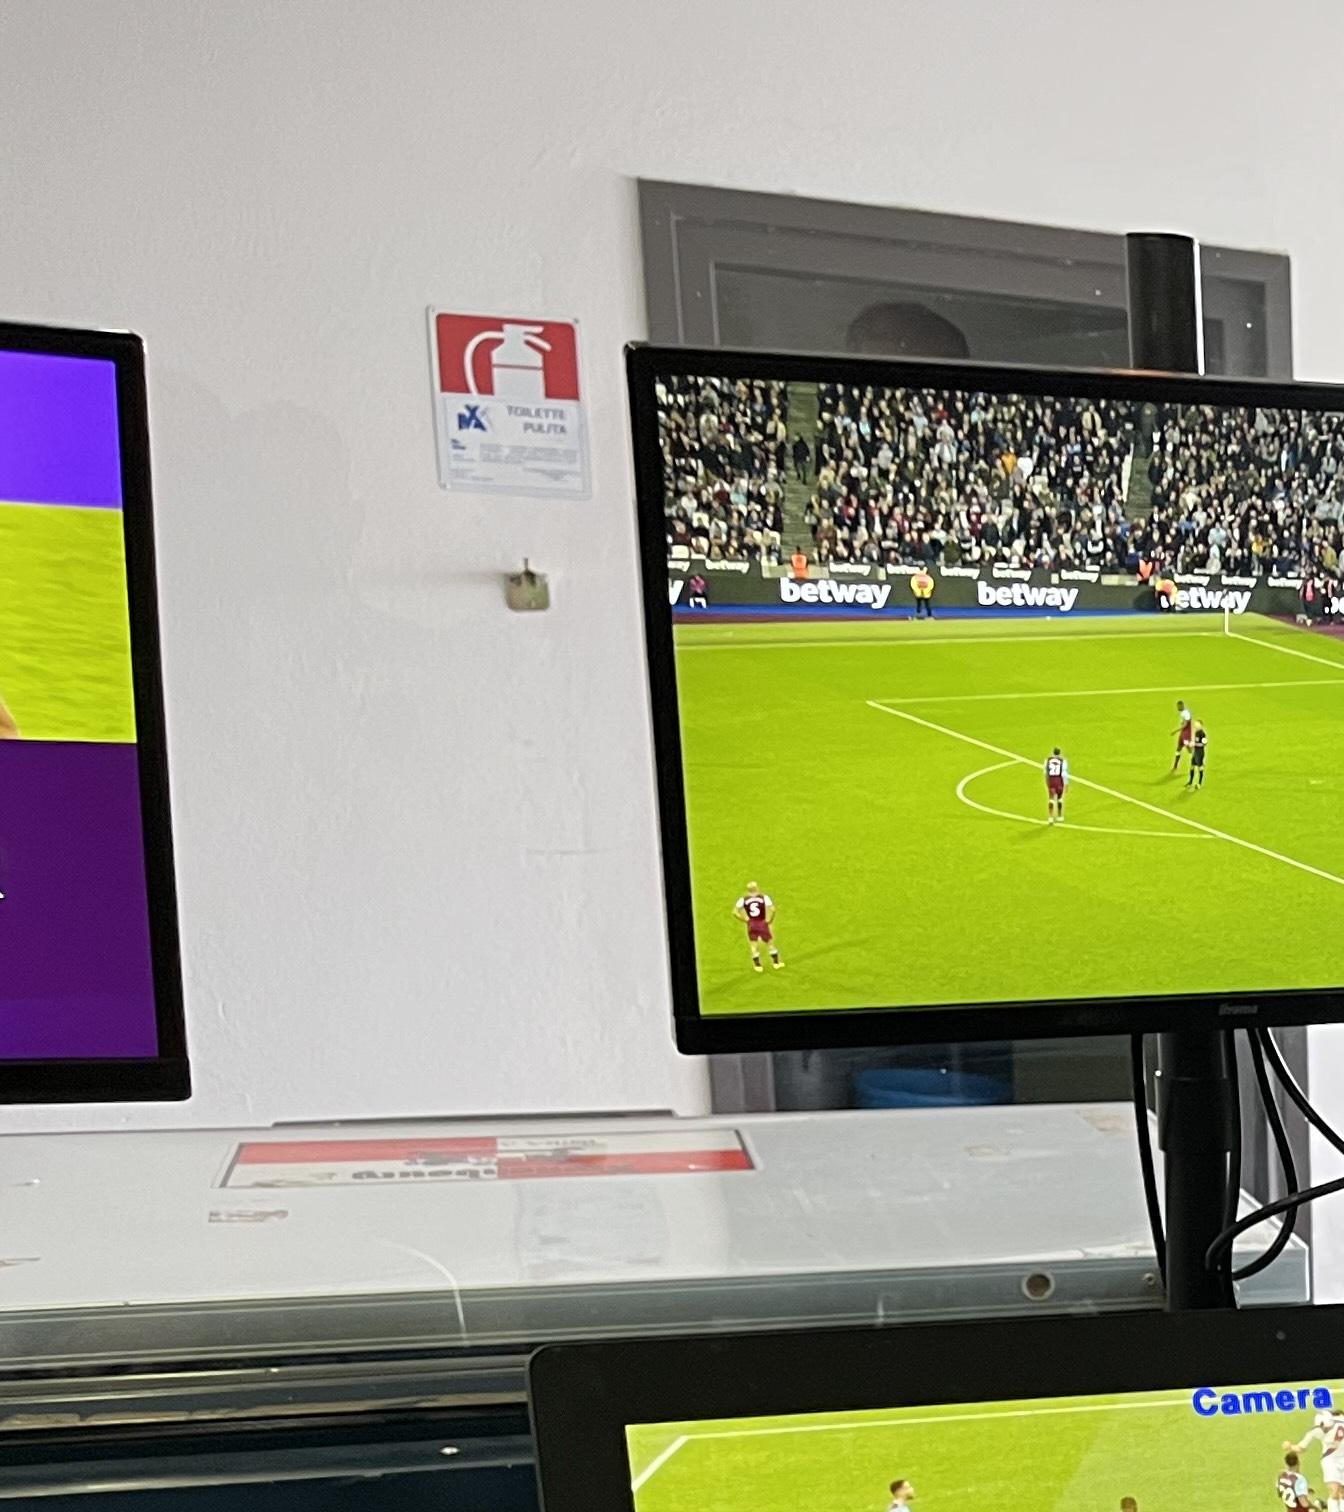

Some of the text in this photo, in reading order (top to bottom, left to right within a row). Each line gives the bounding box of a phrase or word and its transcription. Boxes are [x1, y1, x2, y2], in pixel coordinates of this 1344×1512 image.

[779, 577, 891, 610] betway
[977, 580, 1079, 611] betway
[1191, 1386, 1333, 1416] Camera
